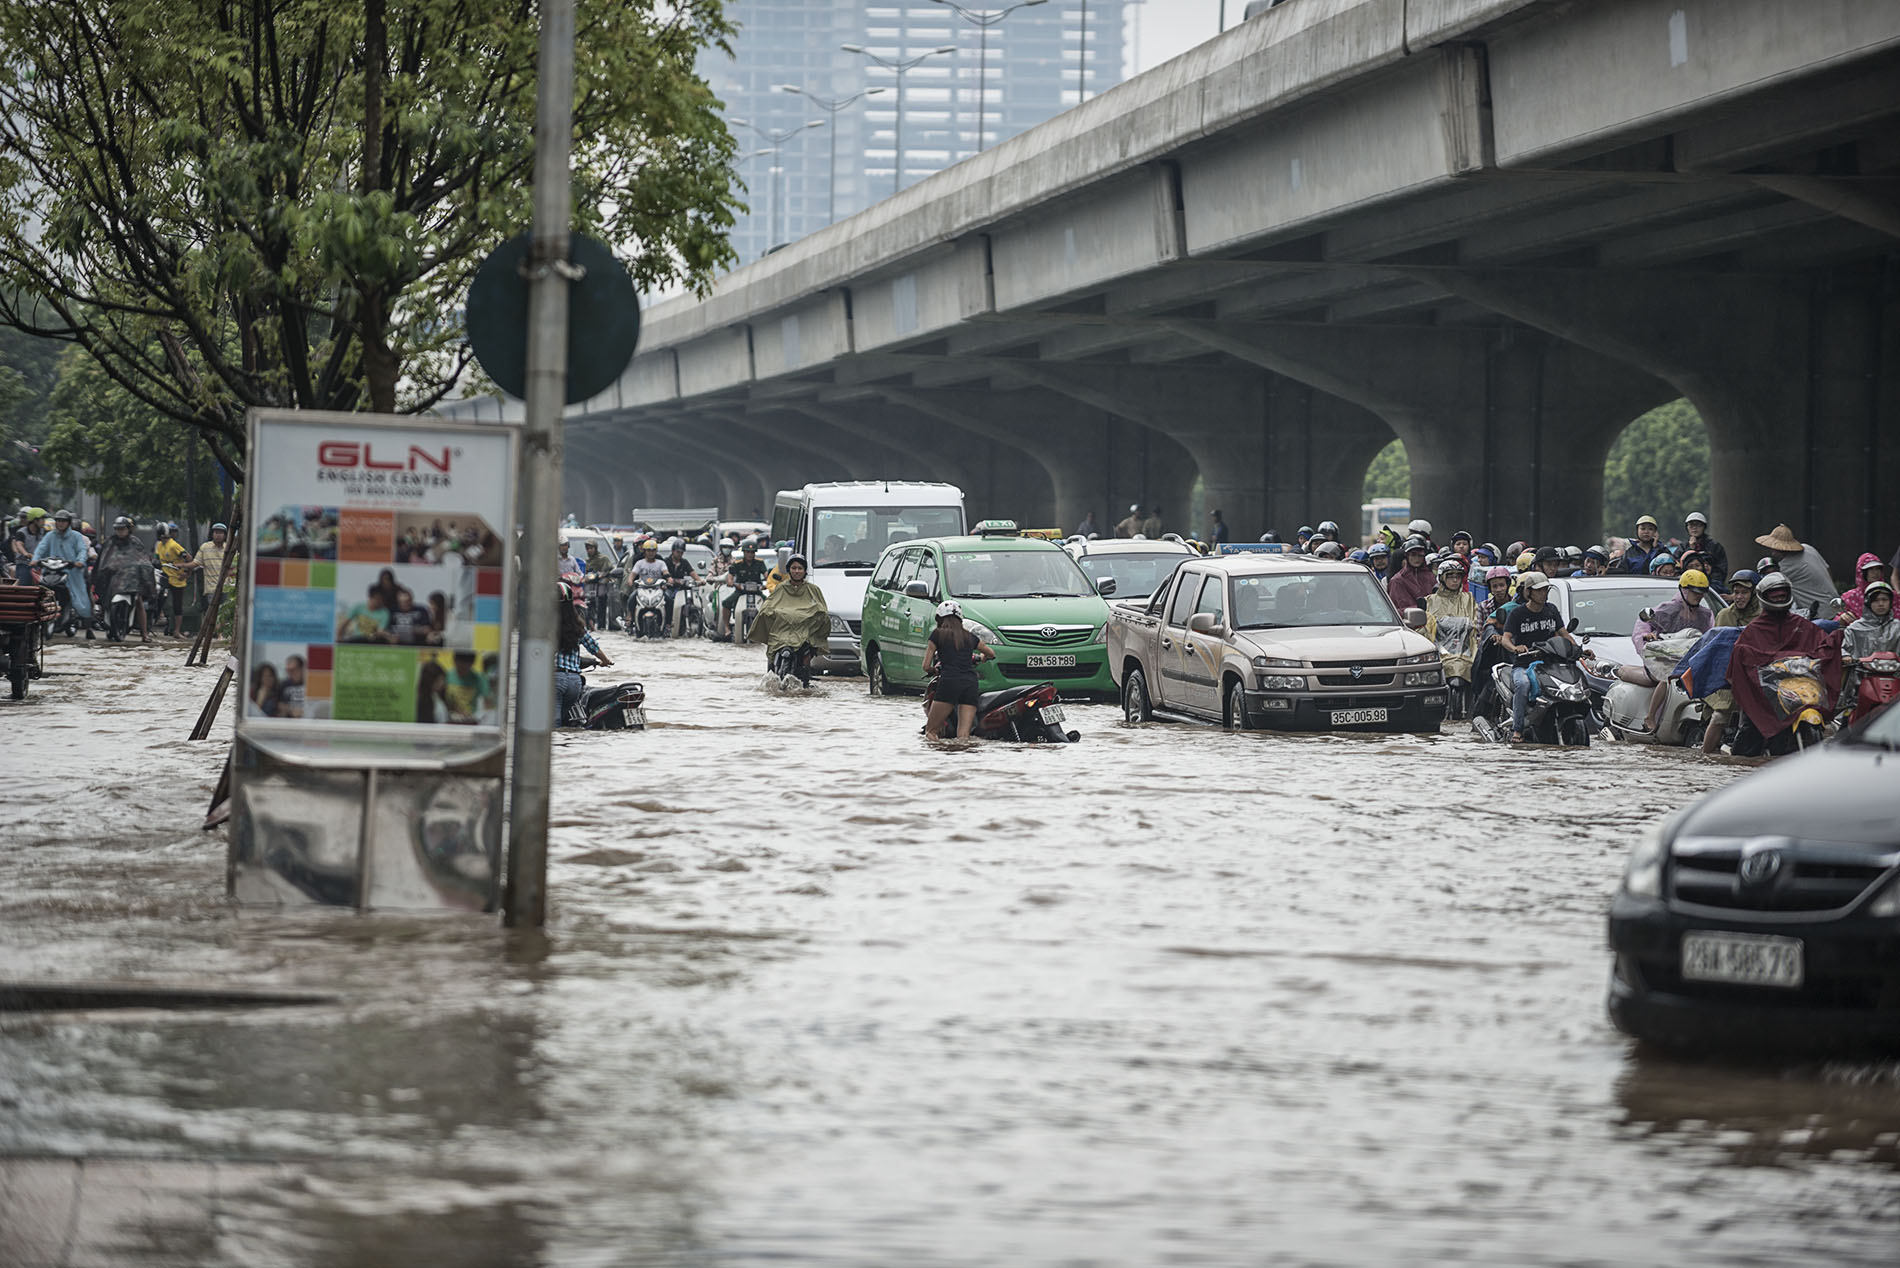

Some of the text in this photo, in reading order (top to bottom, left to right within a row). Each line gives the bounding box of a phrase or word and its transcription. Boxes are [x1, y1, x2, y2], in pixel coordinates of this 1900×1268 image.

[317, 468, 452, 488] ENGLISH CENTER
[1332, 710, 1386, 723] 35C-005.98
